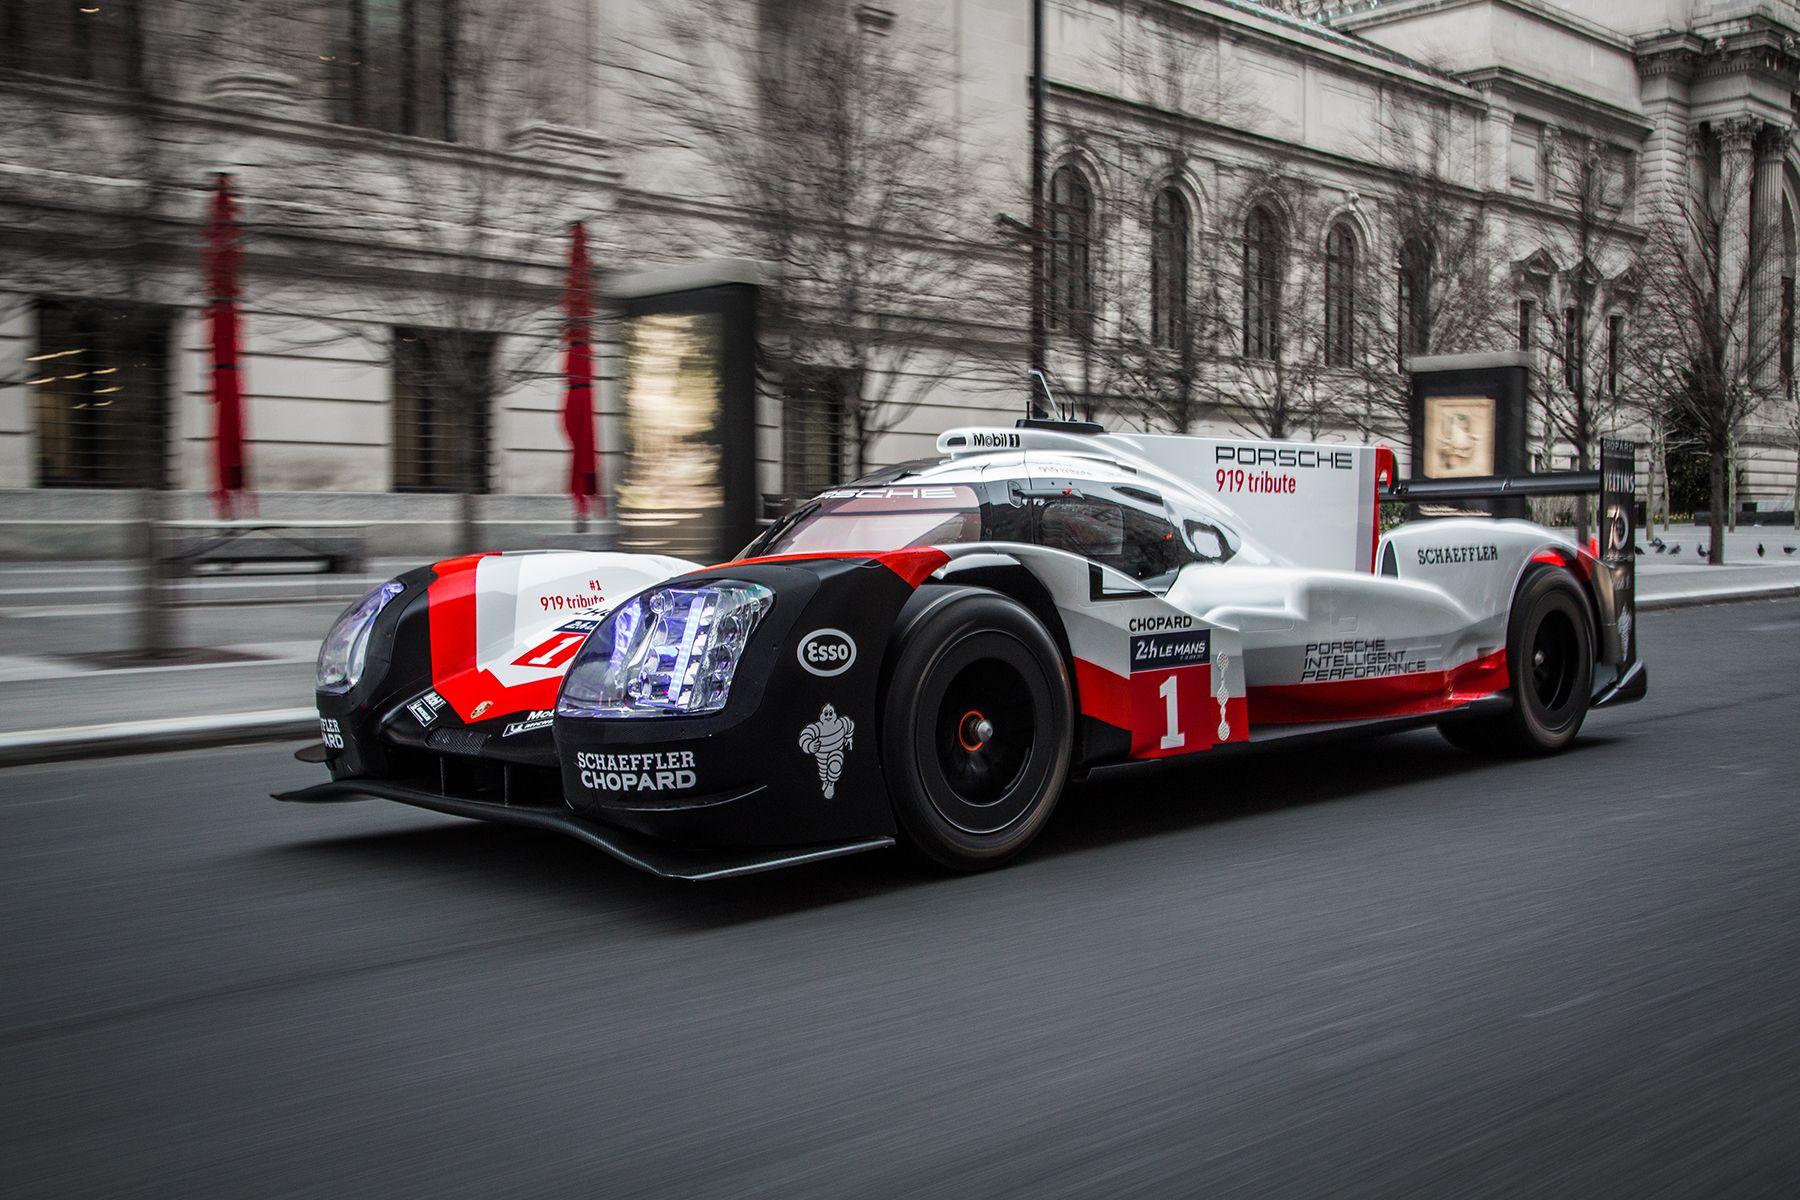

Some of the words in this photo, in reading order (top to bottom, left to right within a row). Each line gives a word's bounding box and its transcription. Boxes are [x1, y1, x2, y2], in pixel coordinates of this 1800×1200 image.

[973, 433, 1007, 447] Mobil
[1215, 446, 1353, 469] PORSCHE
[1216, 469, 1244, 493] 919
[1248, 470, 1296, 494] tribute
[1417, 545, 1499, 565] SCHAEFFLER
[589, 580, 602, 591] #1
[541, 595, 564, 611] 919
[1129, 615, 1193, 632] CHOPARD
[528, 635, 586, 665] 1
[1135, 638, 1158, 661] 24h
[1159, 645, 1173, 657] LE
[1174, 641, 1206, 656] MANS
[1305, 640, 1385, 656] PORSCHE
[1304, 651, 1407, 670] INTELLIGENT
[1300, 660, 1426, 682] PERFORMANCE
[1159, 675, 1186, 750] 1
[577, 751, 696, 771] SCHAEFFLER
[581, 770, 697, 792] CHOPARD
